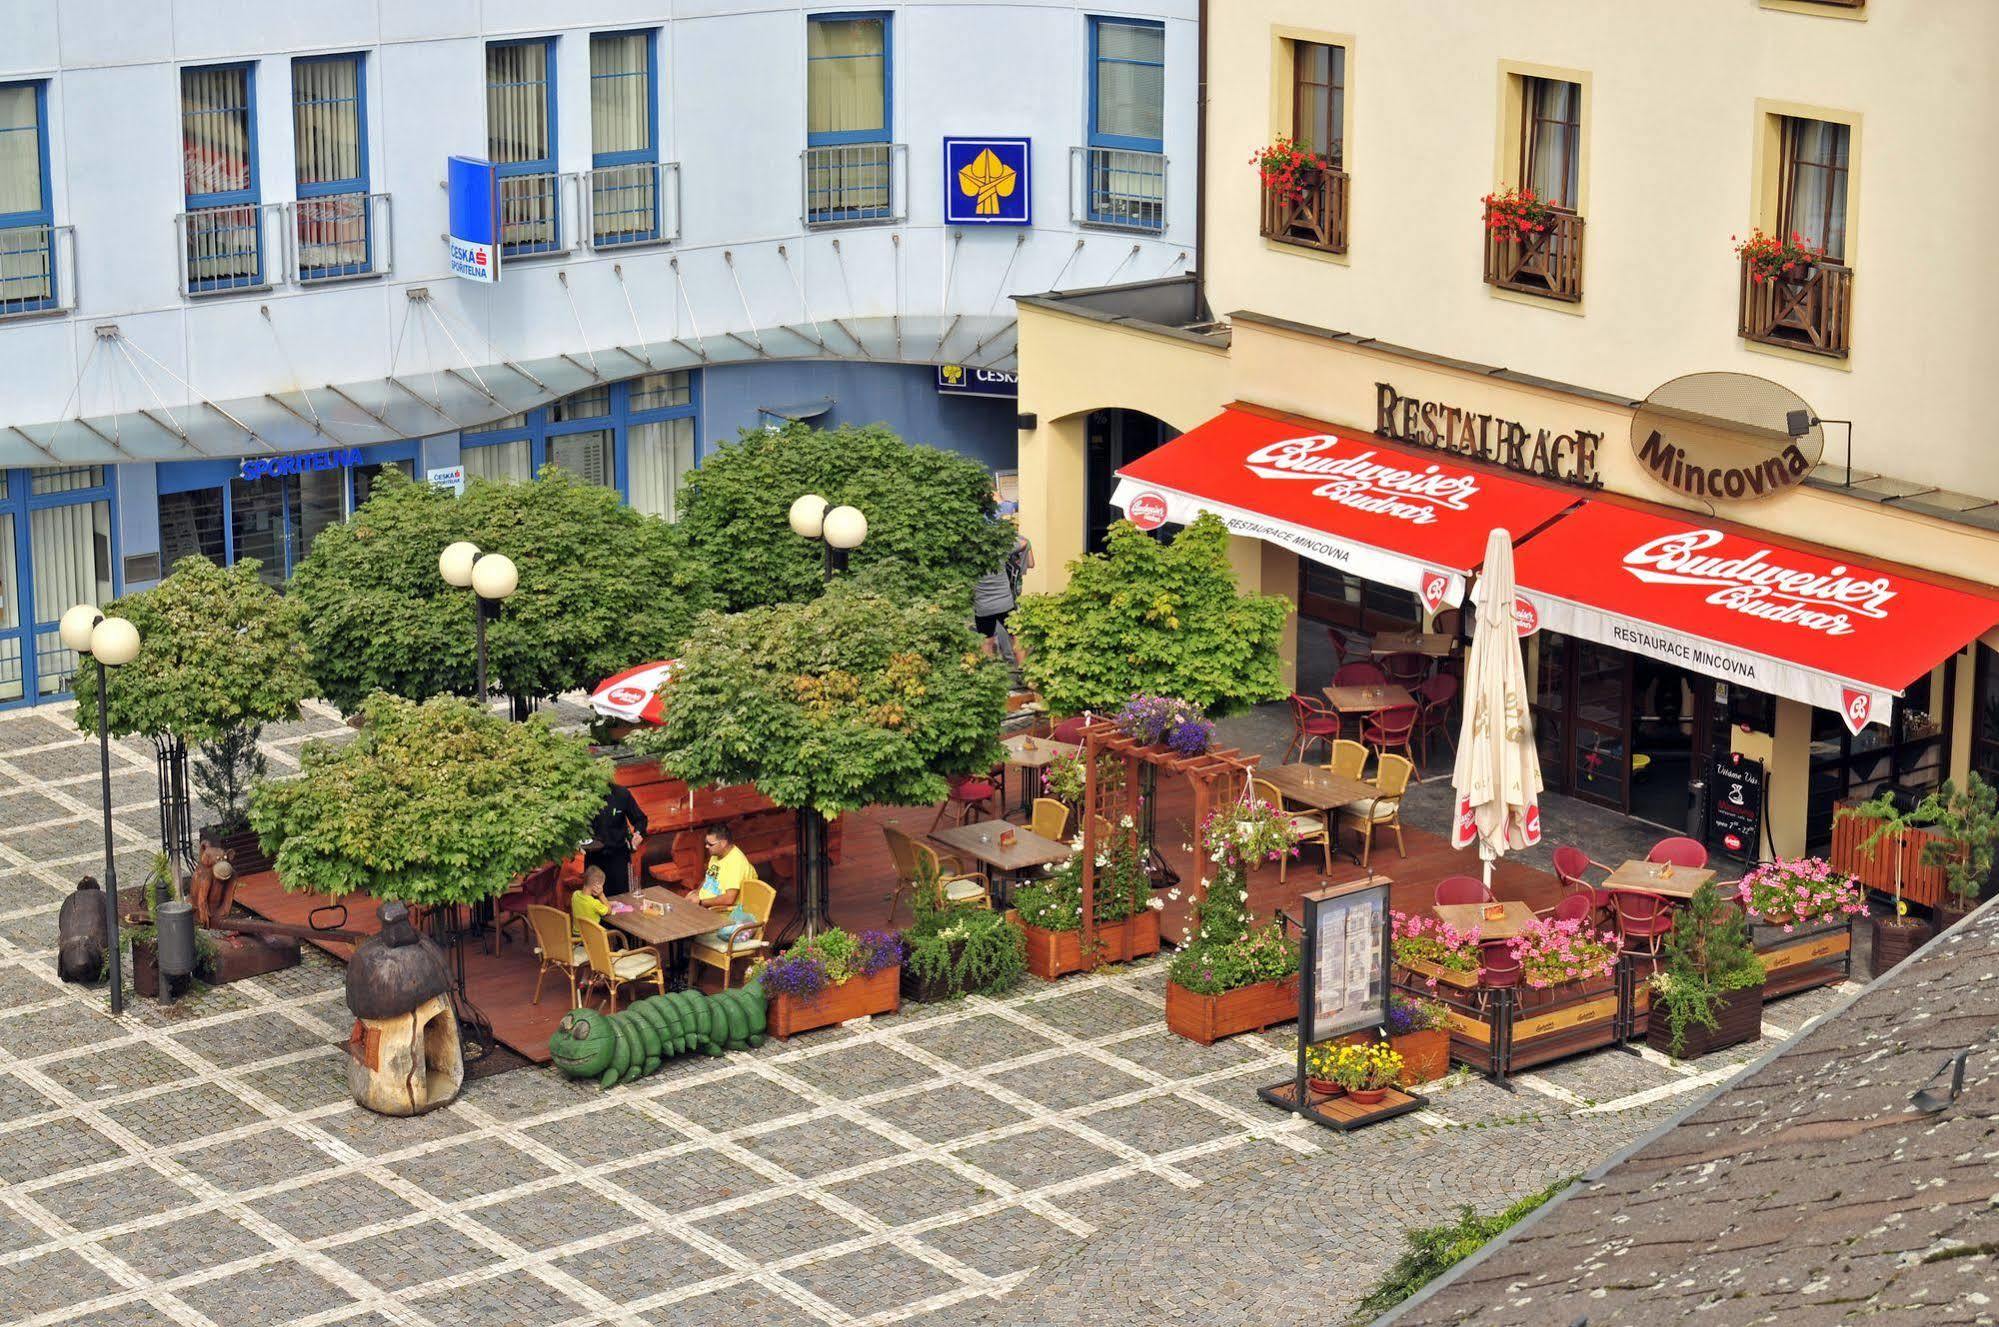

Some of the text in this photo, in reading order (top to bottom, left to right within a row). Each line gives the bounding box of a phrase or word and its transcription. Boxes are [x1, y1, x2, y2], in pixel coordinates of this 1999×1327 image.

[1374, 381, 1605, 489] RESTAURACE
[1638, 429, 1810, 499] Mincovna
[1244, 434, 1481, 511] Budweiser
[1312, 480, 1439, 525] Budvar
[1226, 518, 1350, 563] RESTAURACE MINCOVNA
[1622, 528, 1898, 619] Budweiser
[1705, 585, 1856, 635] Budvar
[1613, 626, 1756, 679] RESTAURACE MINCOVNA
